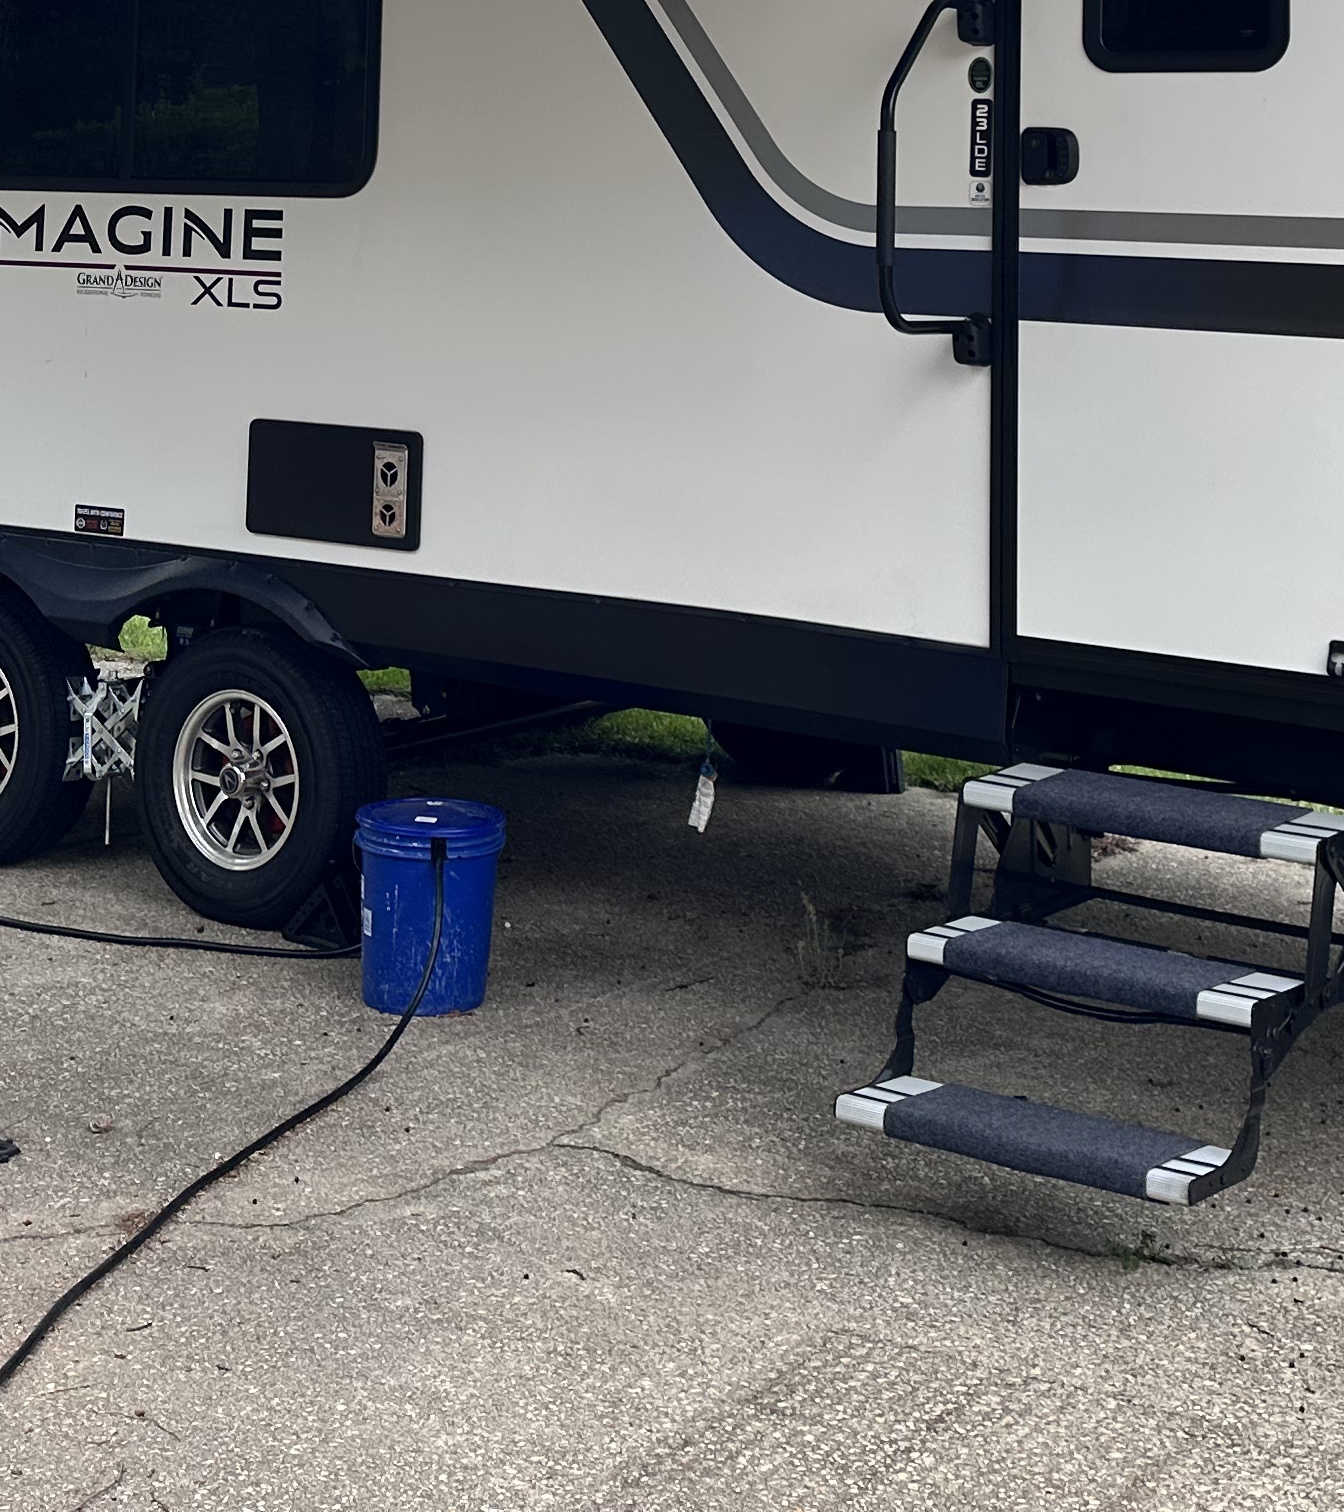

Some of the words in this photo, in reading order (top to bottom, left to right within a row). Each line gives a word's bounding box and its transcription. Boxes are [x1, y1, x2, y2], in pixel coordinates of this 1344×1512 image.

[975, 104, 988, 170] 23LDE
[77, 273, 114, 286] GRAND
[125, 275, 162, 288] DESIGN
[191, 276, 282, 310] XLS
